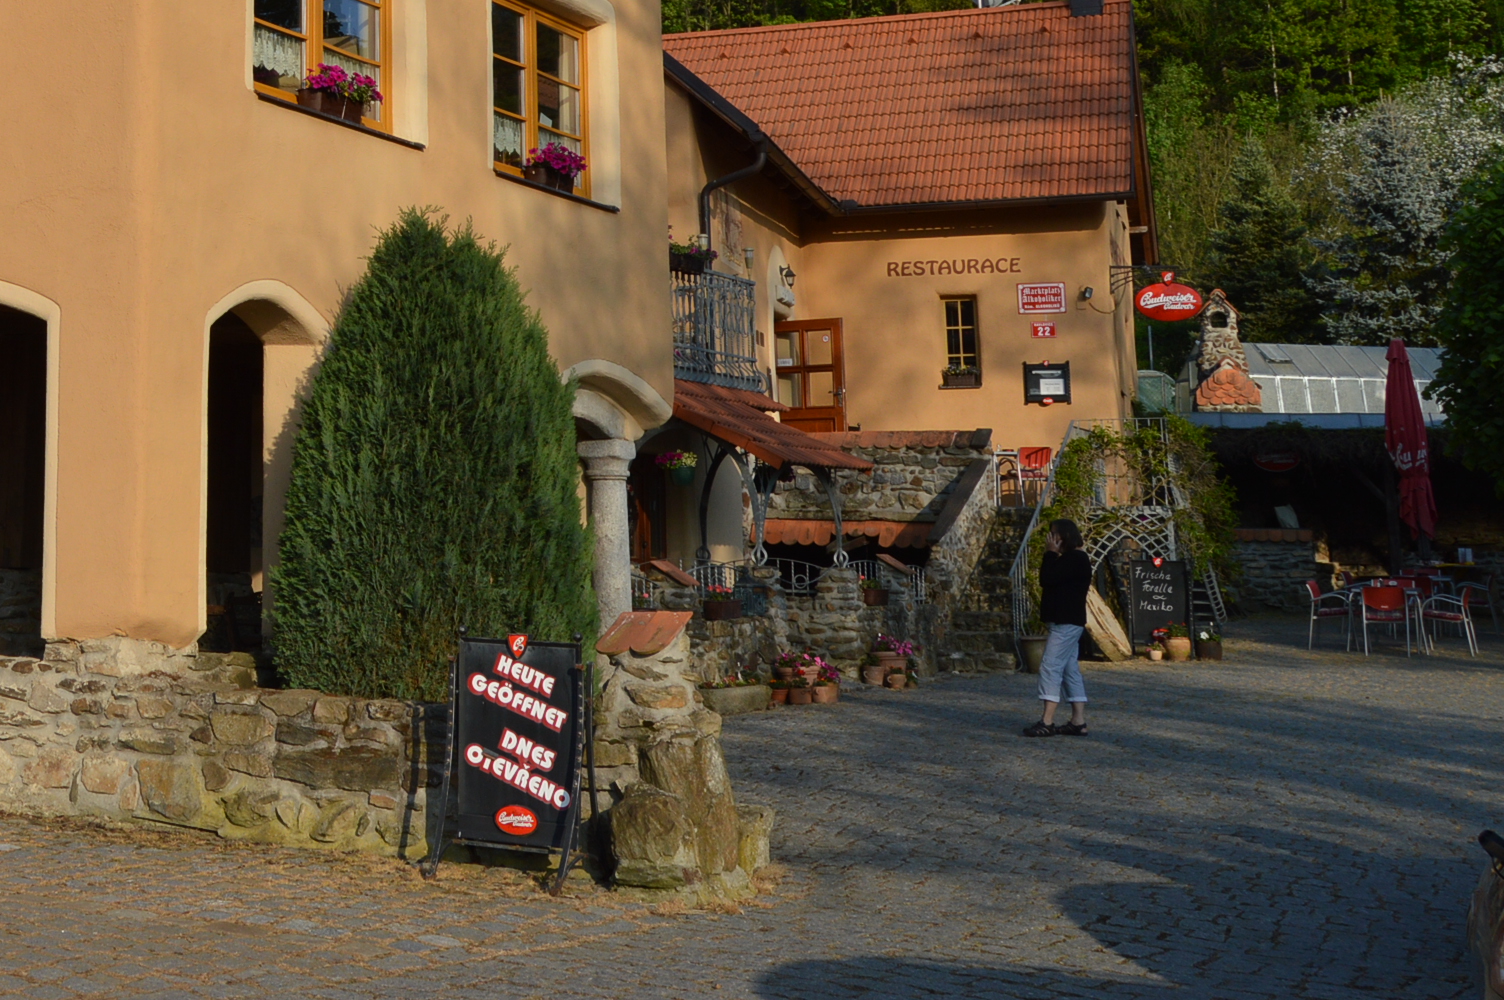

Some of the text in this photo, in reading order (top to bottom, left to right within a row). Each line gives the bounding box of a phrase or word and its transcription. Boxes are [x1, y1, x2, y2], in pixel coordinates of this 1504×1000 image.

[887, 257, 1021, 277] RESTAURACE
[1140, 291, 1197, 308] Budweiser
[1163, 302, 1195, 310] Budvar
[1037, 326, 1051, 336] 22
[497, 654, 556, 694] HEUTE
[471, 674, 567, 729] GEÖFFNET
[501, 730, 555, 769] DNES
